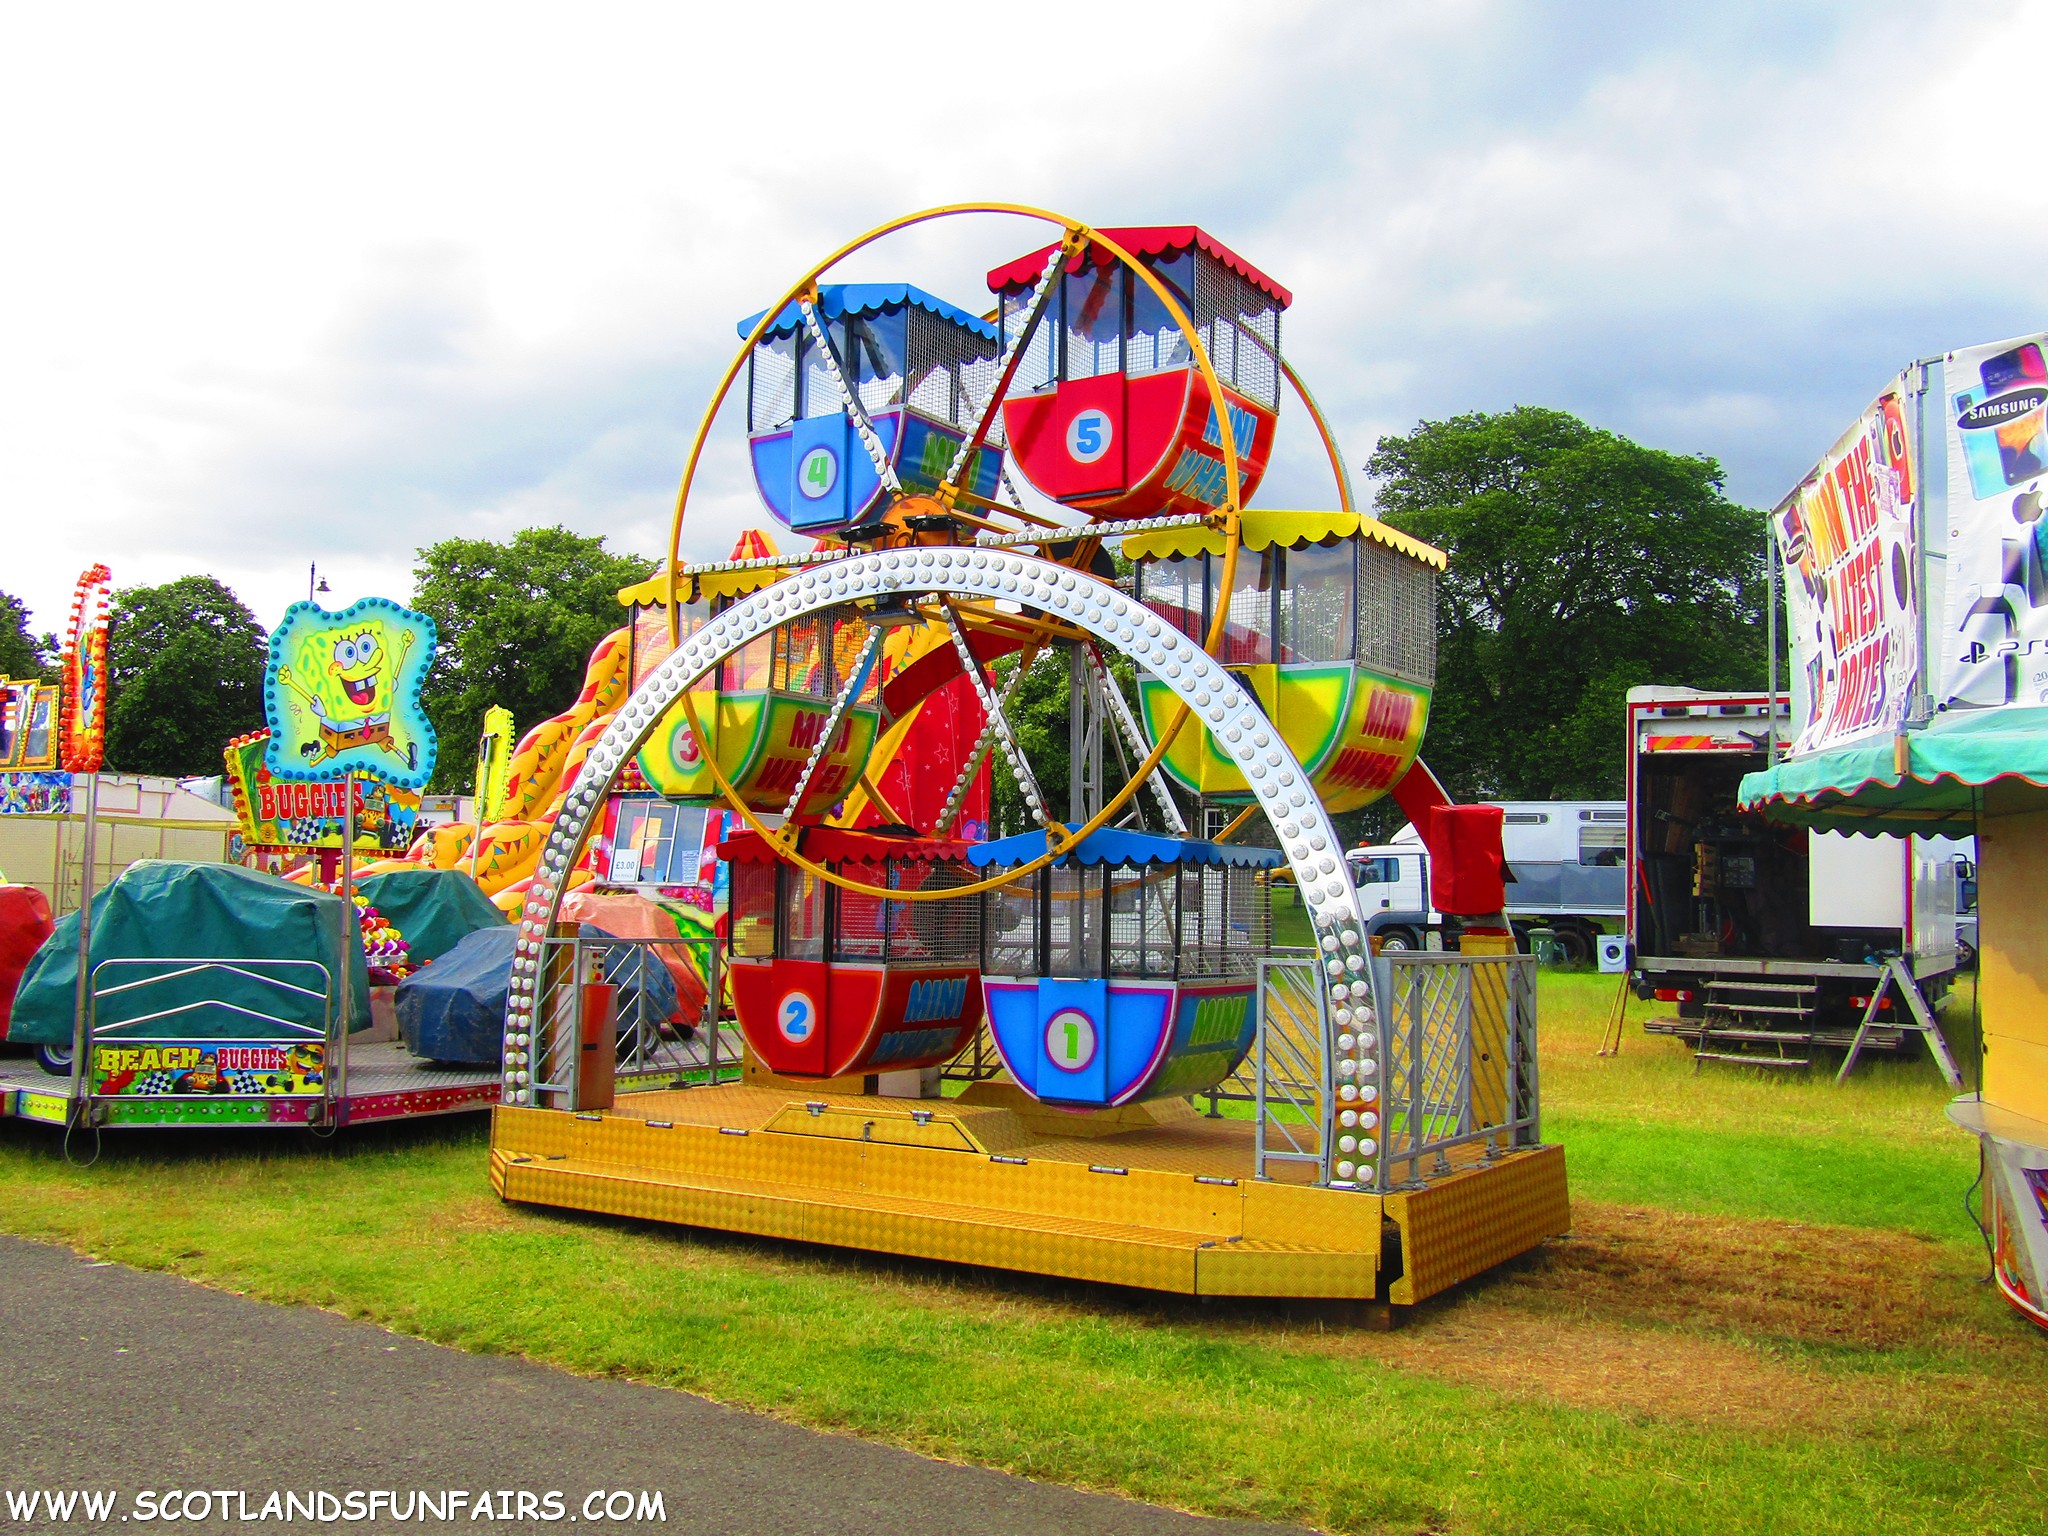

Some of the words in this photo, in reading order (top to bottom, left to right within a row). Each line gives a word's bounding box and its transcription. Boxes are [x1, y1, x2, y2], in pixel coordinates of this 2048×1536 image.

[1969, 397, 2038, 420] SAMSUNG
[1077, 418, 1102, 454] 5
[807, 456, 828, 487] 4
[920, 431, 982, 491] MII
[1163, 446, 1248, 508] WHE
[1835, 434, 1879, 547] THE
[1829, 535, 1886, 658] LATEST
[1997, 638, 2048, 658] PS
[1824, 632, 1890, 740] PRIZES
[788, 709, 853, 753] MII
[1360, 687, 1415, 743] MINI
[680, 730, 700, 762] 3
[755, 756, 850, 794] WHEL
[259, 782, 365, 821] BUGGIES
[615, 861, 635, 870] £3.00
[786, 1000, 808, 1035] 2
[903, 978, 968, 1023] MINI
[1188, 996, 1248, 1046] MINI
[99, 1047, 201, 1072] BEACH
[217, 1047, 288, 1071] BUGGIES
[1063, 1022, 1079, 1059] 1
